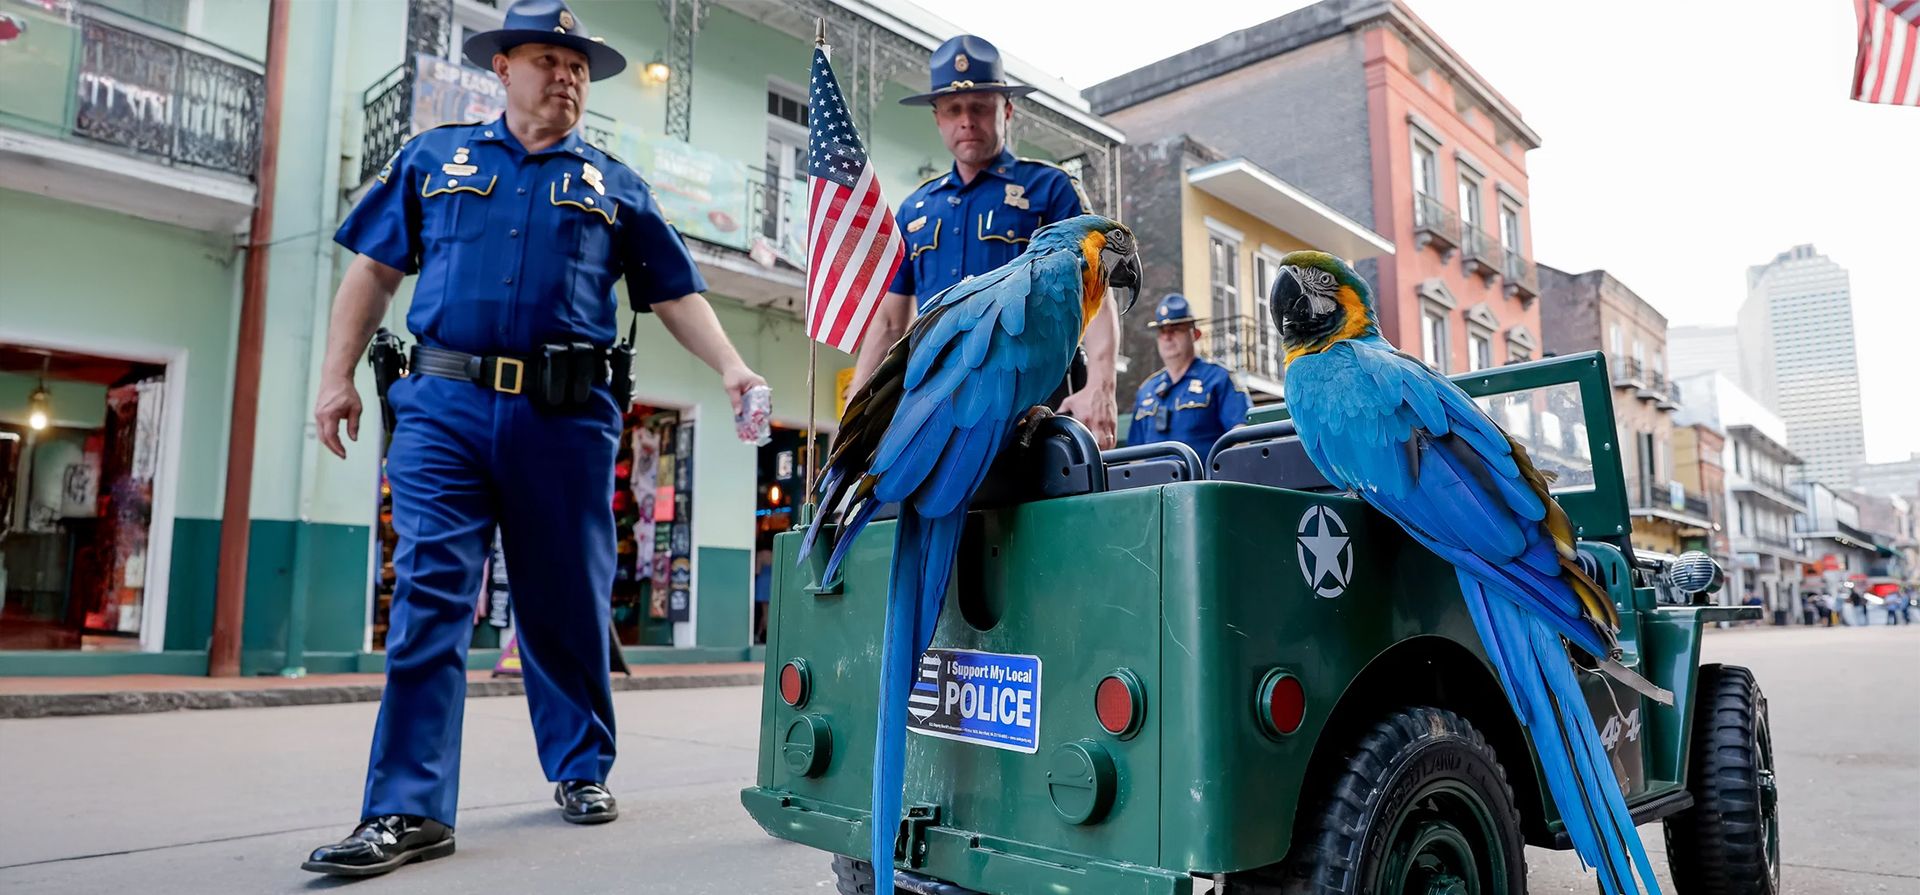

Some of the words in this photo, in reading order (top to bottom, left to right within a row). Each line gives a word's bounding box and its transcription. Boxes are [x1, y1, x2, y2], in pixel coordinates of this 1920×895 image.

[947, 661, 951, 675] I
[952, 661, 989, 680] Support
[990, 665, 1005, 684] My
[1006, 666, 1032, 684] Local
[945, 681, 1032, 728] POLICE
[1600, 707, 1642, 751] 44
